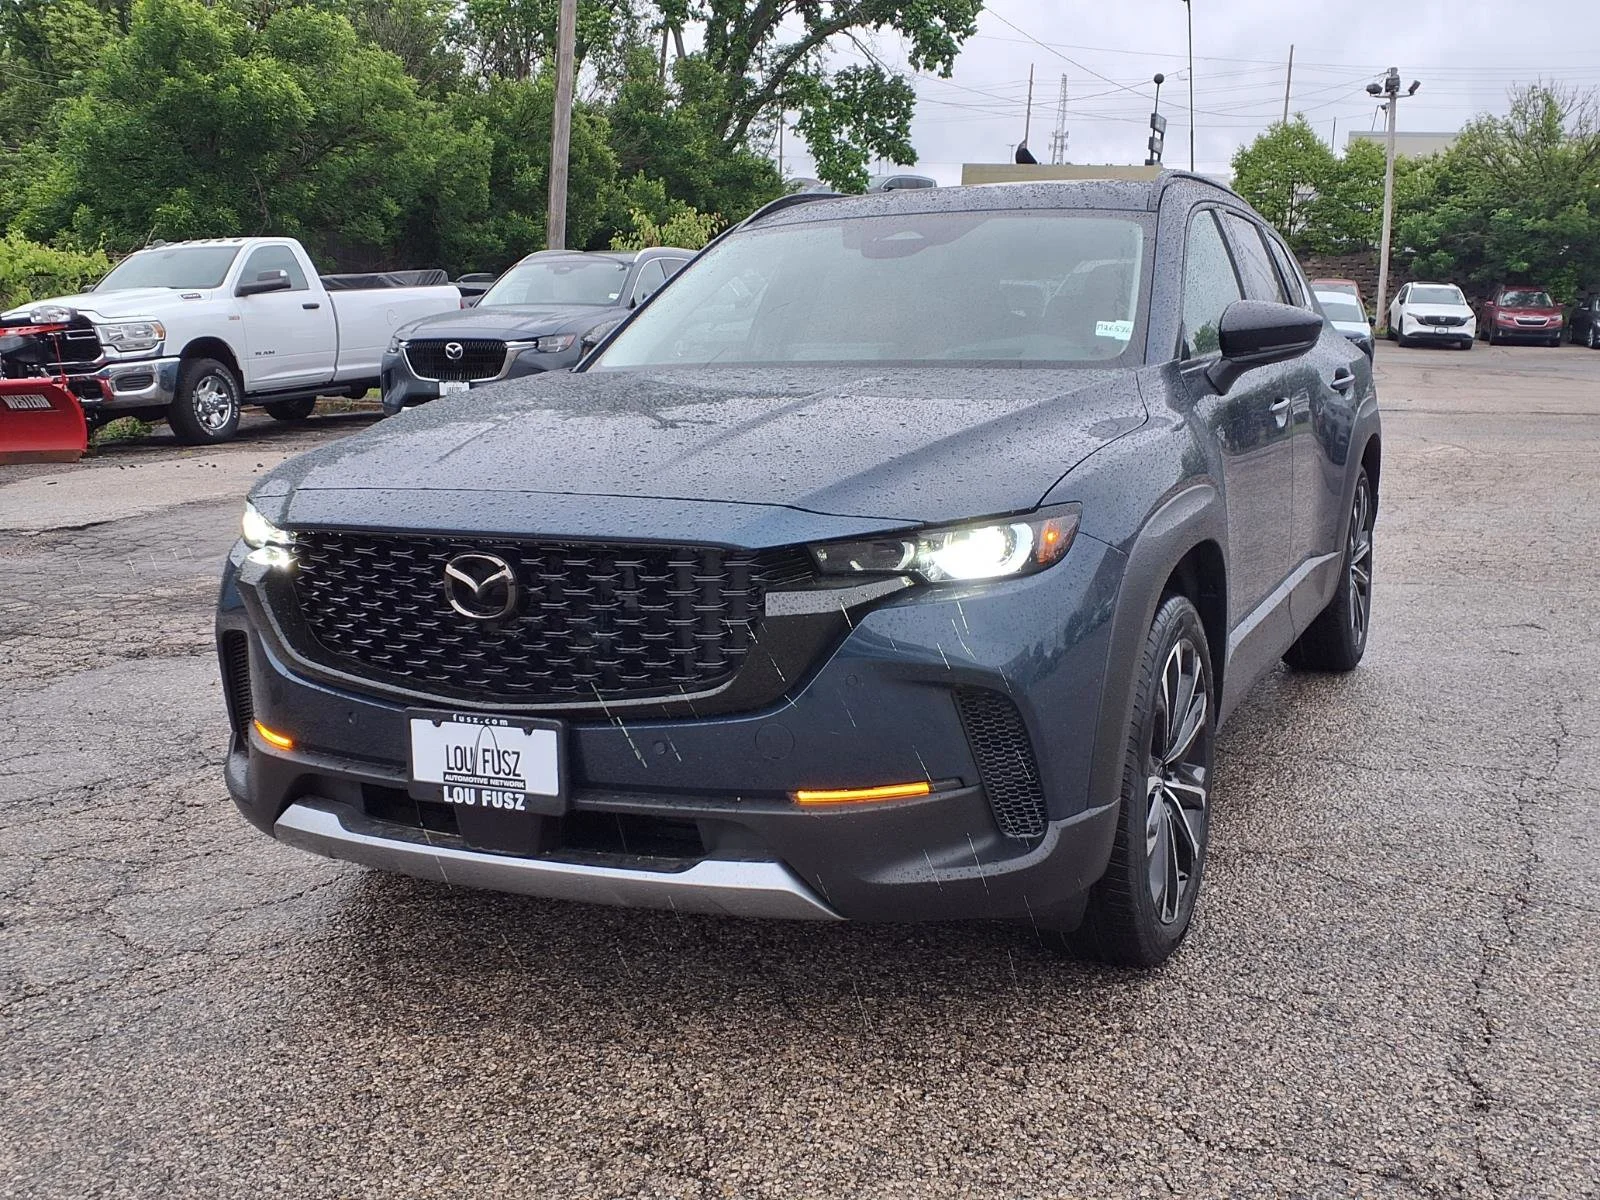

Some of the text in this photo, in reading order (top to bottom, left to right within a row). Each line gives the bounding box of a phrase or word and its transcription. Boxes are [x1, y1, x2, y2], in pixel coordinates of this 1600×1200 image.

[0, 394, 52, 409] WESTERN
[452, 713, 509, 726] fusz.com
[446, 744, 522, 777] LOU FUSZ
[444, 774, 525, 788] AUTOMOTIVE NETWORK
[443, 785, 526, 811] LOU FUSZ
